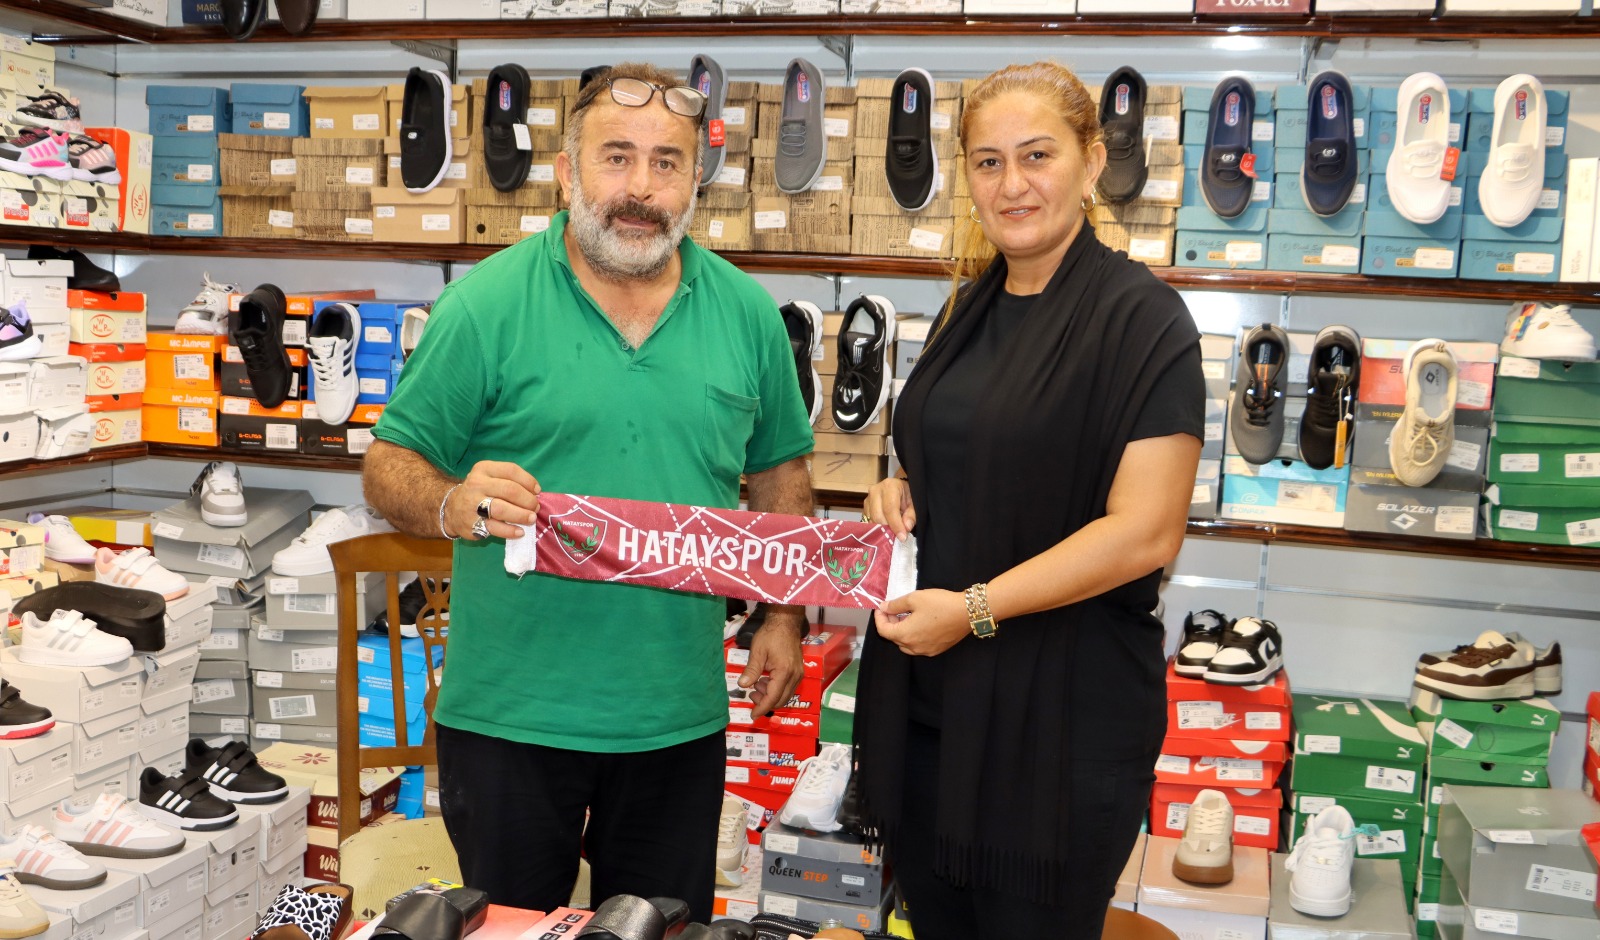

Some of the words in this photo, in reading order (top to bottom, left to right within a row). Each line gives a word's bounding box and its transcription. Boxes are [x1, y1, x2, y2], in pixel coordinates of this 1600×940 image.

[1376, 503, 1436, 514] SOLAZER
[562, 520, 594, 528] HATAYSPOR
[618, 526, 807, 577] HATAYSPOR
[781, 716, 801, 726] UMP
[770, 775, 795, 785] JUMP
[769, 865, 802, 878] QUEEN
[803, 870, 829, 882] STEP
